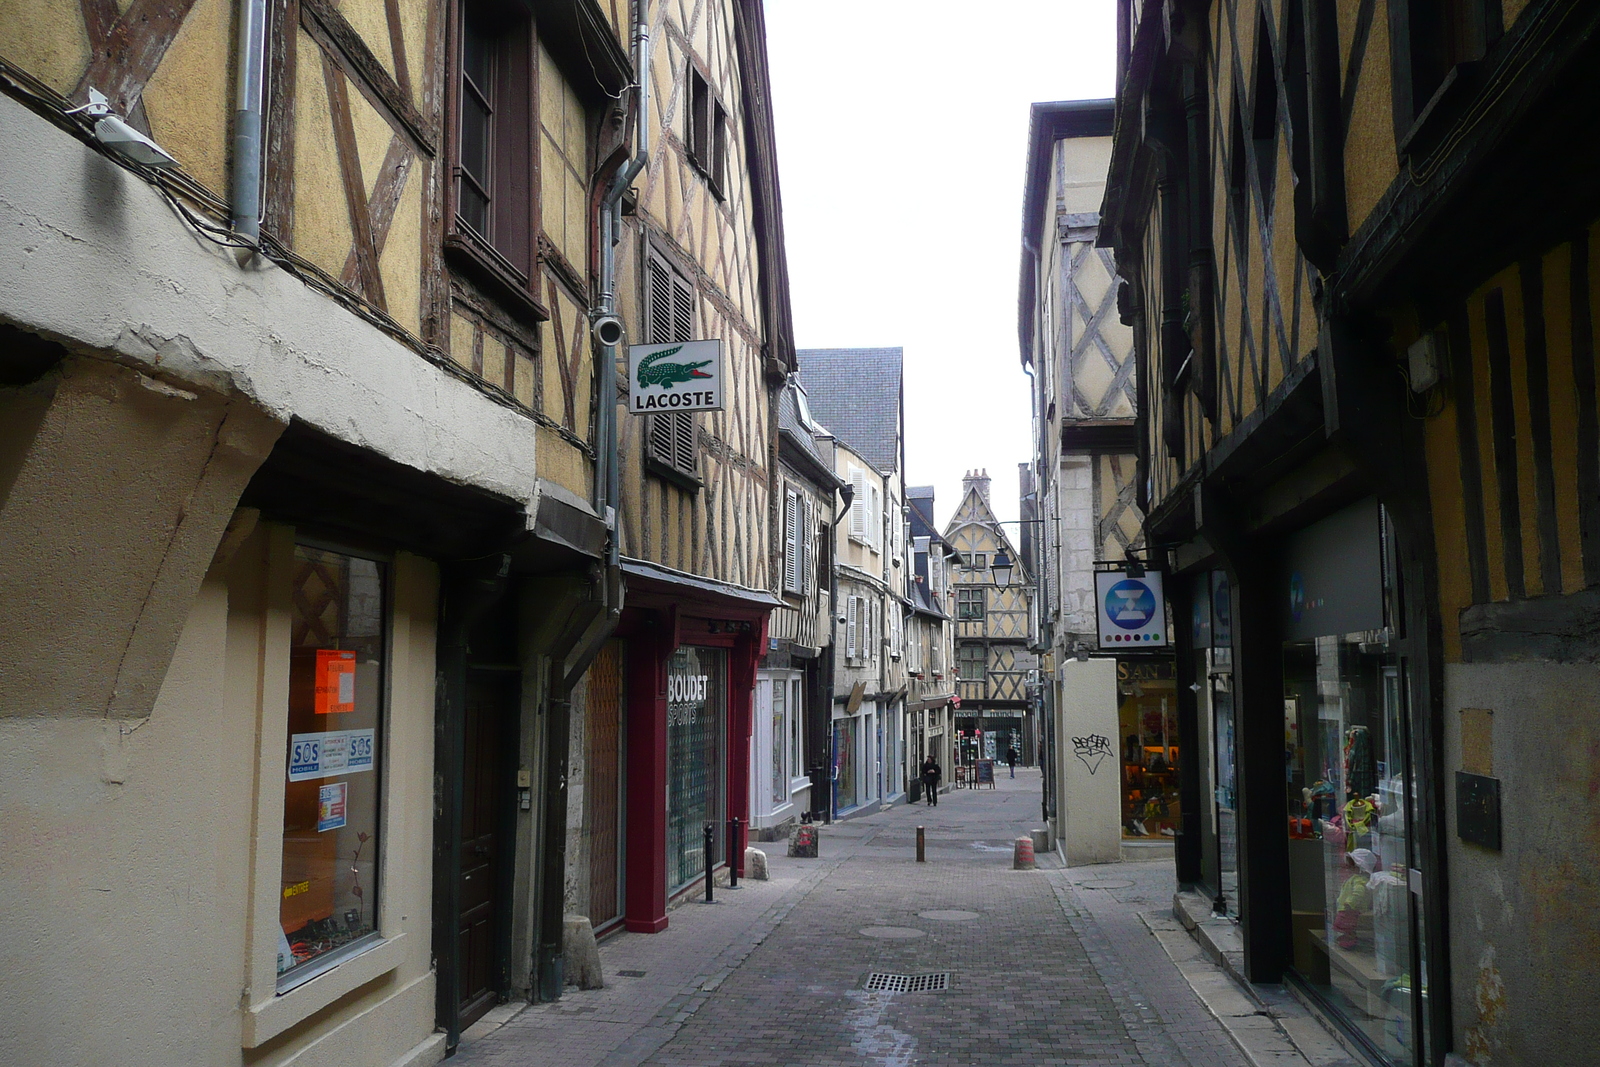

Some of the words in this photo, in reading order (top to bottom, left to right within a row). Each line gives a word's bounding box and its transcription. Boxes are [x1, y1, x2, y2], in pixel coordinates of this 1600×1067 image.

[636, 391, 714, 409] LACOSTE
[668, 674, 708, 702] BOUDET
[668, 702, 697, 727] SPORTS
[294, 743, 318, 763] SOS
[351, 738, 371, 756] SOS
[292, 764, 318, 773] MOBILE
[349, 757, 371, 766] MOBILE
